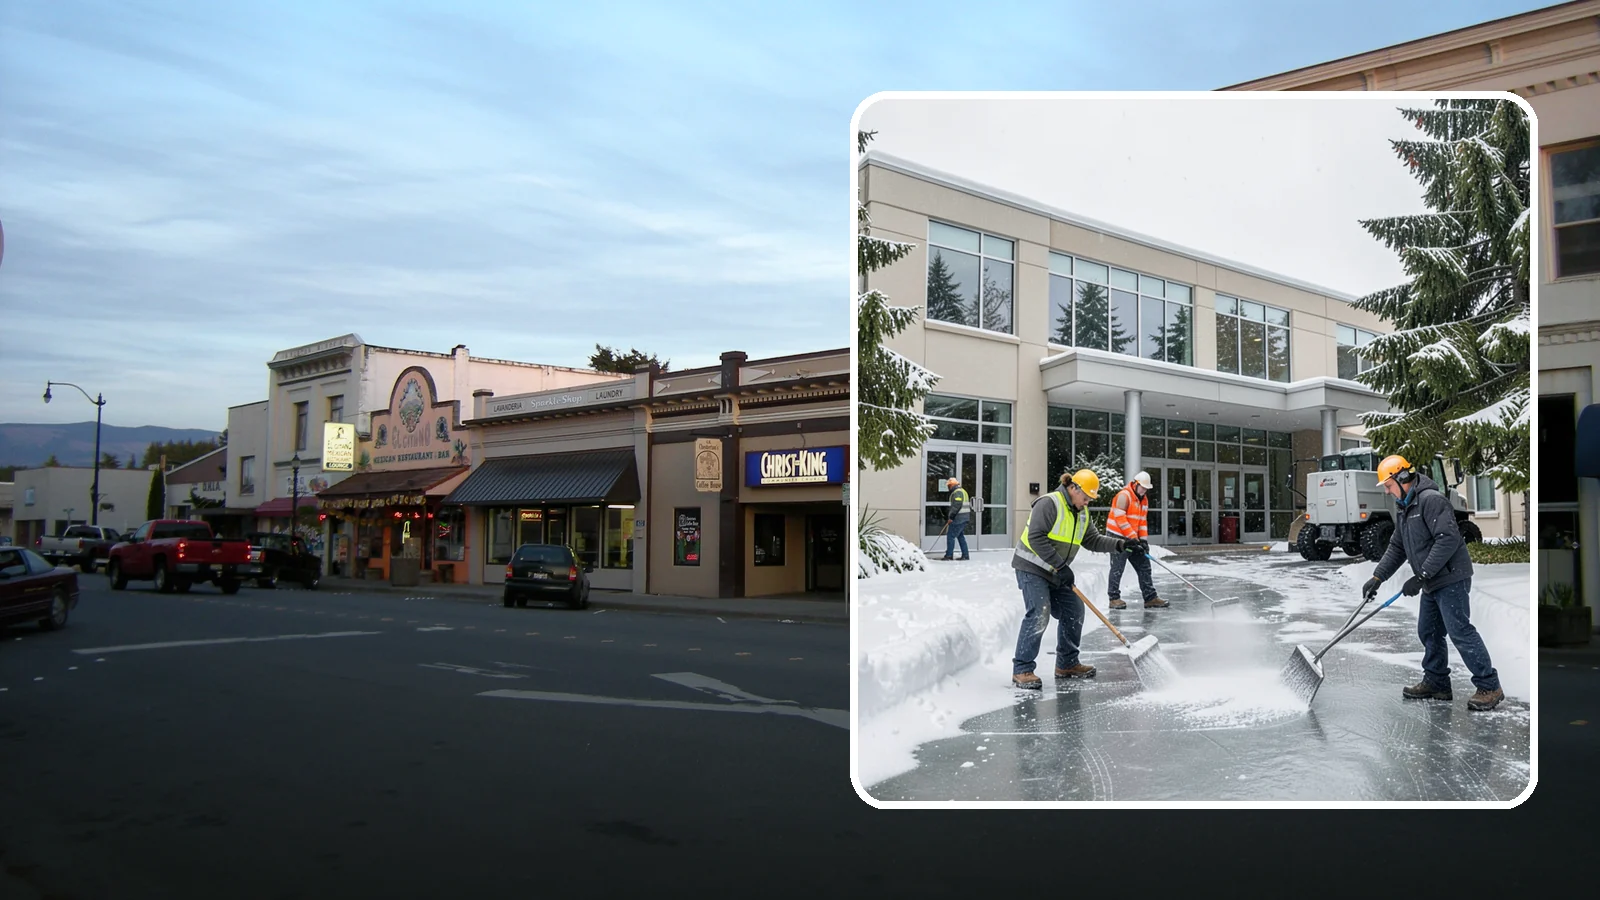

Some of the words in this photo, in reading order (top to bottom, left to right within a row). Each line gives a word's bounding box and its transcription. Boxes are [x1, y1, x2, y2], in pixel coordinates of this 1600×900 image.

[493, 402, 522, 413] LAVANDERIA
[562, 394, 583, 405] Shop
[595, 389, 623, 400] LAUNDRY
[374, 455, 396, 464] MEXICAN
[398, 451, 433, 462] RESTAURANT
[438, 450, 450, 459] BAR
[760, 452, 798, 478] CHRIST
[799, 450, 827, 476] KING
